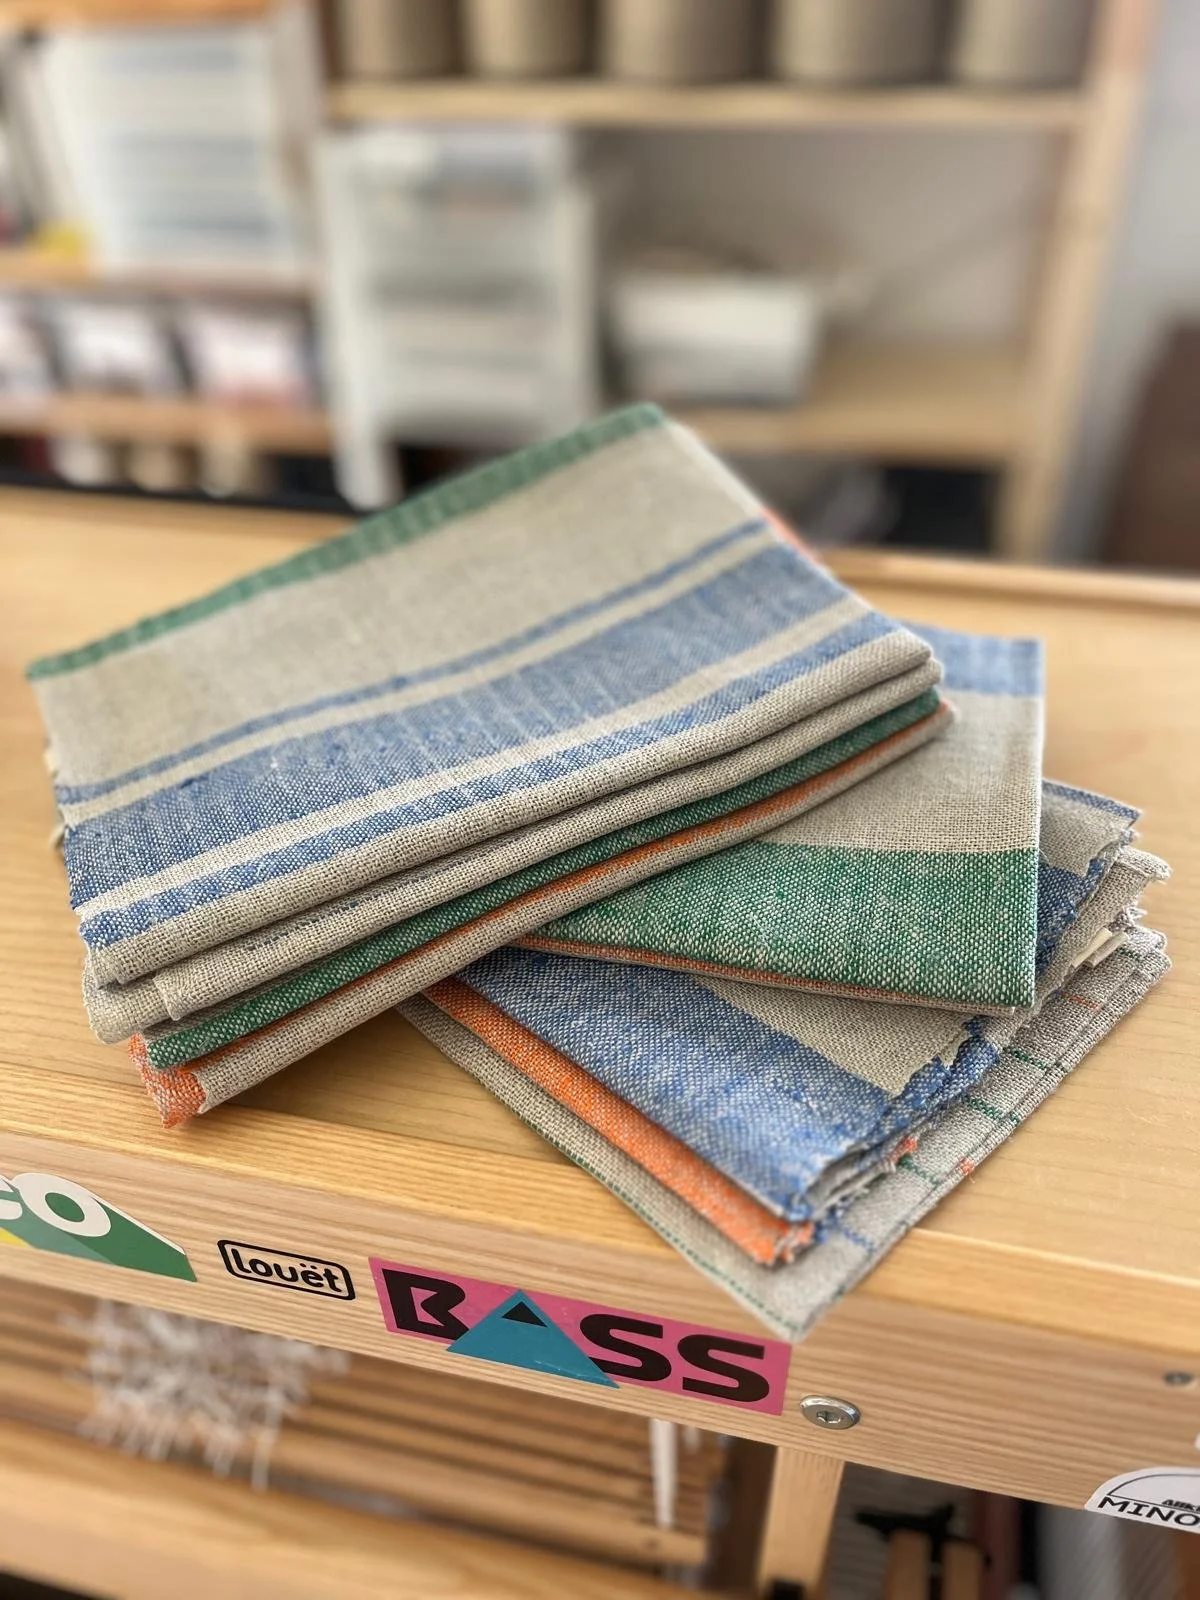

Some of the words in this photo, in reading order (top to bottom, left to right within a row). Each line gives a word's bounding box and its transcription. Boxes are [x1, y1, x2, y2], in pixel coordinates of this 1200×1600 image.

[0, 1173, 111, 1237] O
[231, 1248, 342, 1293] louët
[381, 1268, 770, 1402] BASS
